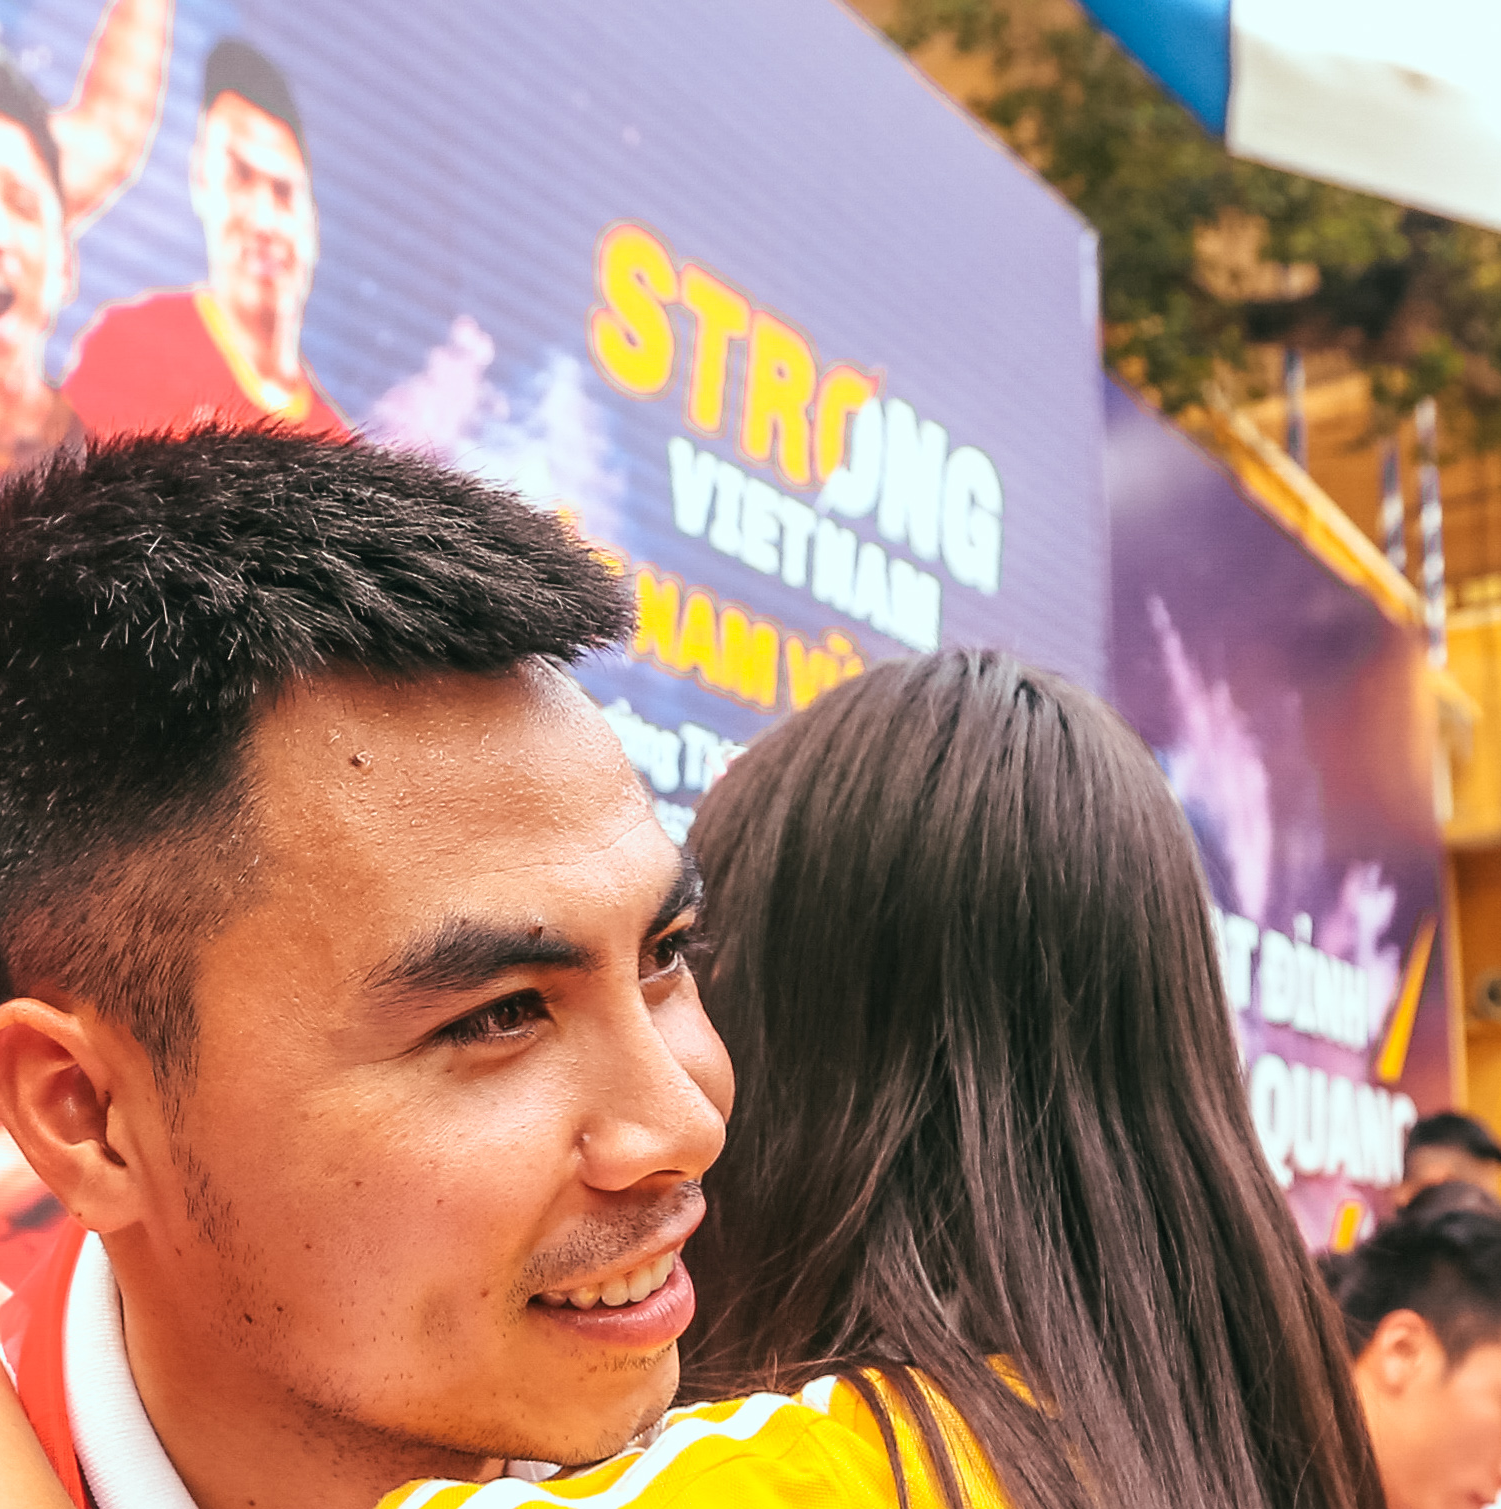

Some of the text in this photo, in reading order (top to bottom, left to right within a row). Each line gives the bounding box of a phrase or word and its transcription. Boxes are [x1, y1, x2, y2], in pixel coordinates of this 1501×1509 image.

[590, 221, 1002, 596] STRONG
[632, 567, 780, 708] NAM
[667, 436, 942, 654] VIETNAM
